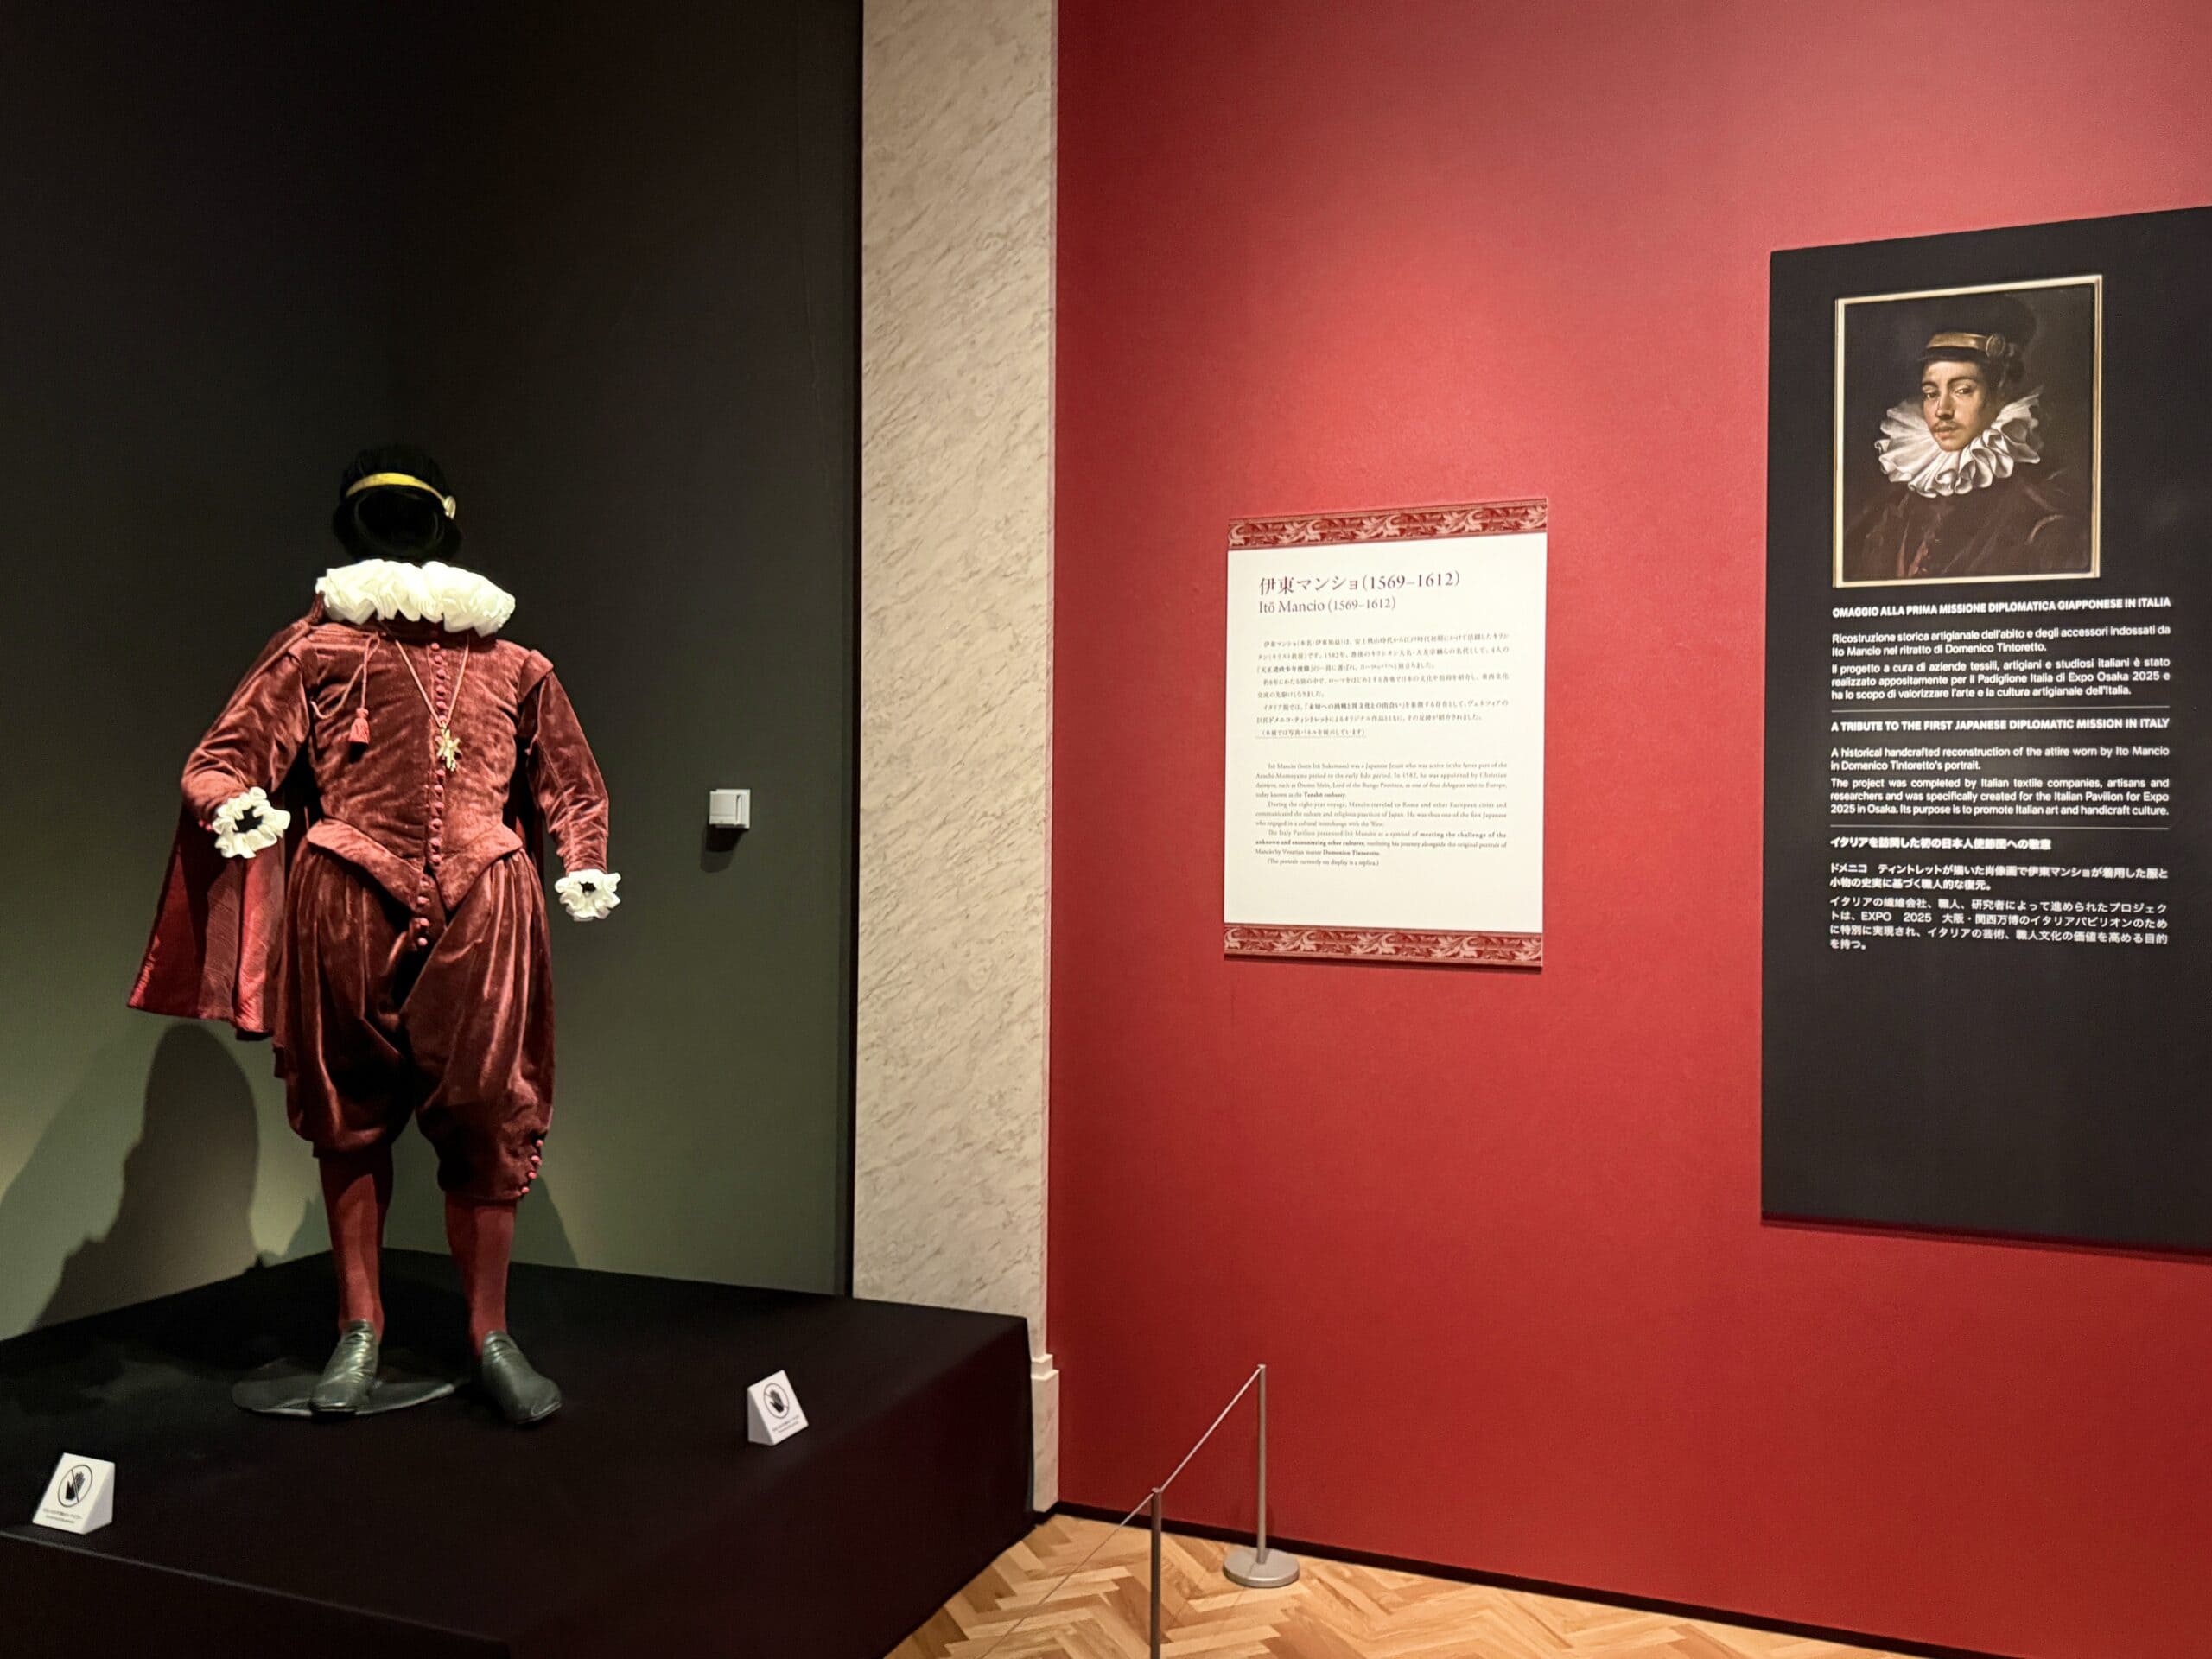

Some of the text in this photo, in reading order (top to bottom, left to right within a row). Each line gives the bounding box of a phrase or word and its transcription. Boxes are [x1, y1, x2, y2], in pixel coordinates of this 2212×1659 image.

[1259, 601, 1275, 613] Itō
[1278, 600, 1325, 613] Mancio
[1832, 597, 2171, 617] OMAGGIO ALLA PRIMA MISSIONE DIPLOMATICA GIAPPONESE IN ITALIA
[1832, 632, 1896, 643] Ricostruzione
[1897, 632, 1929, 641] storica
[1930, 630, 1980, 642] artigianale
[1980, 628, 2025, 639] dell'abito
[2034, 627, 2059, 639] degli
[2060, 626, 2108, 637] accessori
[2110, 625, 2155, 635] indossati
[2157, 625, 2171, 634] da
[1831, 642, 2046, 656] Ito Mancio nel ritratto di Domenico Tintoretto.
[1831, 664, 1837, 673] Il
[1839, 664, 1880, 675] progetto
[1892, 664, 1914, 672] cura
[1916, 662, 1926, 671] di
[1929, 661, 1967, 671] aziende
[1969, 660, 1999, 671] tessili,
[2002, 660, 2042, 671] artigiani
[2055, 658, 2094, 668] studiosi
[2097, 658, 2130, 667] italiani
[2133, 658, 2140, 667] è
[2144, 658, 2171, 666] stato
[1830, 677, 1877, 686] realizzato
[1878, 675, 1948, 687] appositamente
[1950, 676, 1967, 686] per
[1968, 674, 1975, 683] il
[1977, 673, 2027, 685] Padiglione
[2030, 672, 2053, 683] Italia
[2055, 672, 2065, 682] di
[2068, 672, 2094, 683] Expo
[2096, 671, 2129, 681] Osaka
[2132, 671, 2160, 680] 2025
[1830, 690, 1844, 699] ha
[1844, 690, 1854, 699] lo
[1855, 690, 1885, 700] scopo
[1886, 689, 1897, 698] di
[1897, 688, 1949, 698] valorizzare
[1951, 688, 1975, 697] l'arte
[1986, 687, 1995, 696] la
[1996, 687, 2031, 696] cultura
[2031, 686, 2083, 697] artigianale
[2084, 685, 2131, 695] dell'Italia.
[1830, 718, 2170, 731] A TRIBUTE TO THE FIRST JAPANESE DIPLOMATIC MISSION IN ITALY
[1830, 747, 1839, 757] A
[1840, 747, 1883, 757] historical
[1884, 747, 1941, 756] handcrafted
[1942, 747, 2011, 756] reconstruction
[2012, 747, 2024, 756] of
[2025, 747, 2042, 756] the
[2044, 747, 2070, 755] attire
[2100, 747, 2113, 757] by
[2115, 747, 2129, 755] Ito
[2132, 746, 2170, 755] Mancio
[1830, 760, 1980, 771] in Domenico Tintoretto's portrait.
[1830, 778, 1849, 787] The
[1851, 778, 1885, 789] project
[1910, 778, 1961, 789] completed
[1963, 778, 1977, 789] by
[1980, 778, 2010, 787] Italian
[2012, 778, 2043, 787] textile
[2046, 778, 2102, 788] companies,
[2107, 778, 2145, 787] artisans
[2150, 779, 2169, 787] and
[1829, 791, 1884, 800] researchers
[1885, 791, 1903, 800] and
[1925, 791, 1978, 802] specifically
[1979, 791, 2017, 800] created
[2018, 791, 2033, 800] for
[2035, 791, 2051, 800] the
[2053, 791, 2083, 801] Italian
[2084, 791, 2124, 801] Pavilion
[2126, 791, 2140, 801] for
[2143, 791, 2169, 803] Expo
[1830, 804, 2169, 816] 2025 in Osaka. Its purpose is to promote Italian art and handicraft culture.
[1830, 863, 1867, 874] ドメニコ
[1903, 912, 1932, 923] 2025
[1829, 938, 1866, 950] を持つ。
